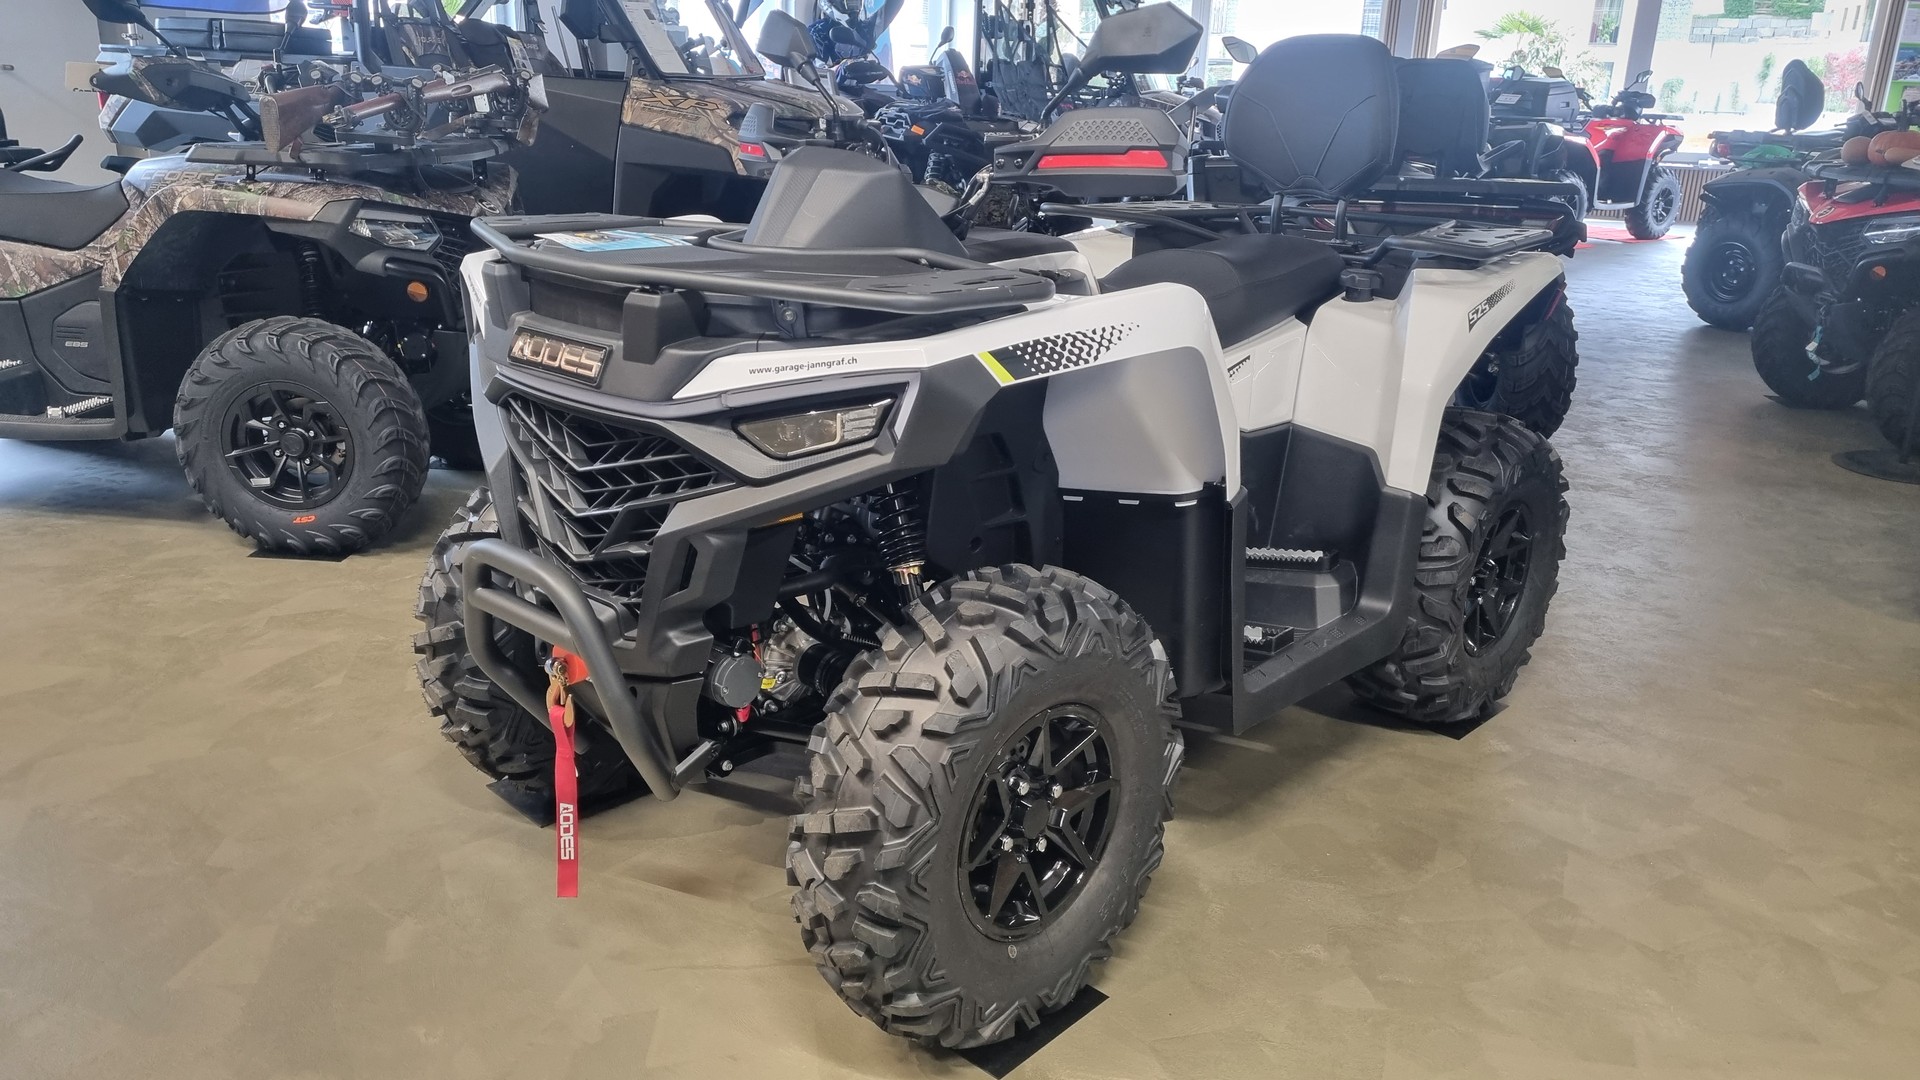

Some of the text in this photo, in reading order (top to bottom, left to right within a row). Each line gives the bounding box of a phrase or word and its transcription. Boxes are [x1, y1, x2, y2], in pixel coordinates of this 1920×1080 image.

[1469, 299, 1490, 325] 525
[748, 356, 858, 375] www.garage-janngraf.ch
[559, 802, 575, 860] AODES
